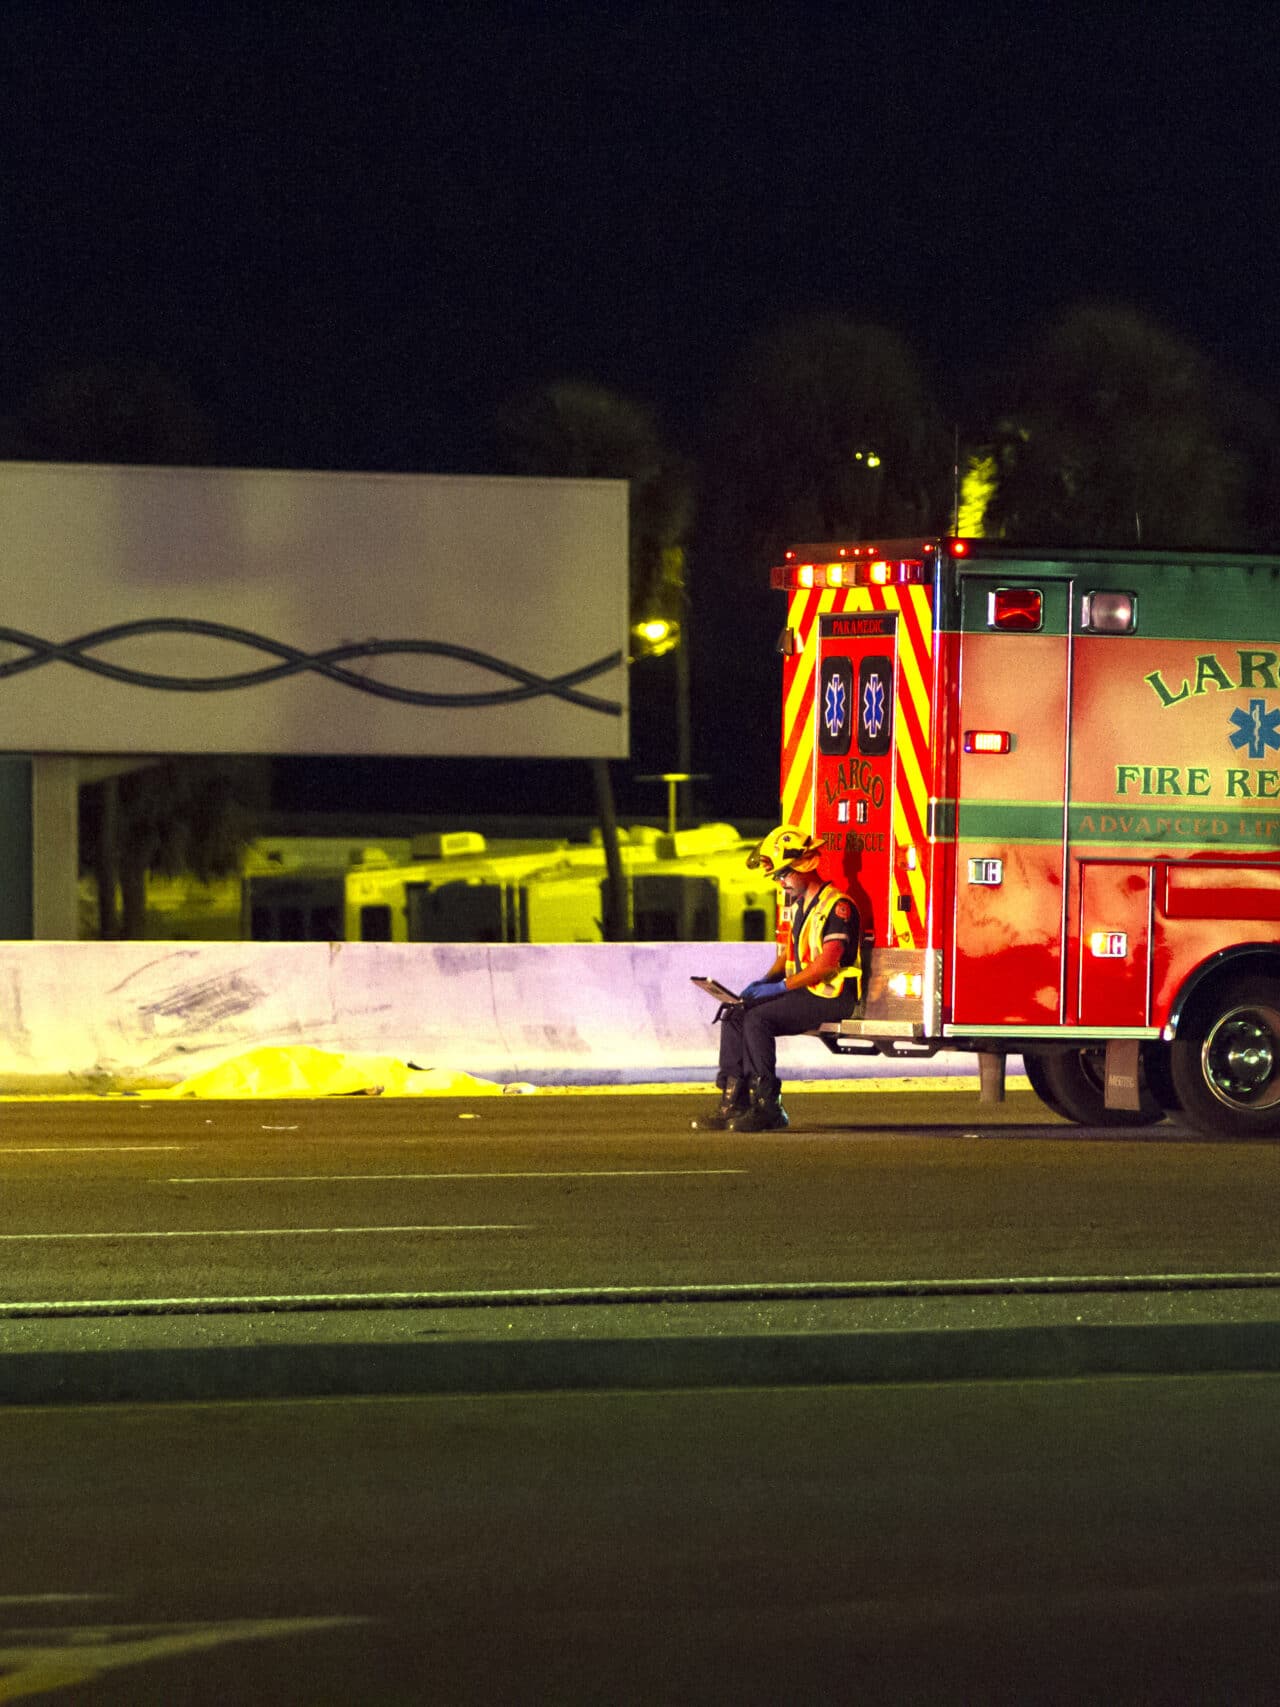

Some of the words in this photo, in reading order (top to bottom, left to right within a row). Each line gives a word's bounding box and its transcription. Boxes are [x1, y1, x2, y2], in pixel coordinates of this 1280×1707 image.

[832, 618, 884, 635] PARAMEDIC
[824, 757, 885, 808] LARGO
[1115, 764, 1212, 797] FIRE
[1078, 814, 1229, 836] ADVANCED
